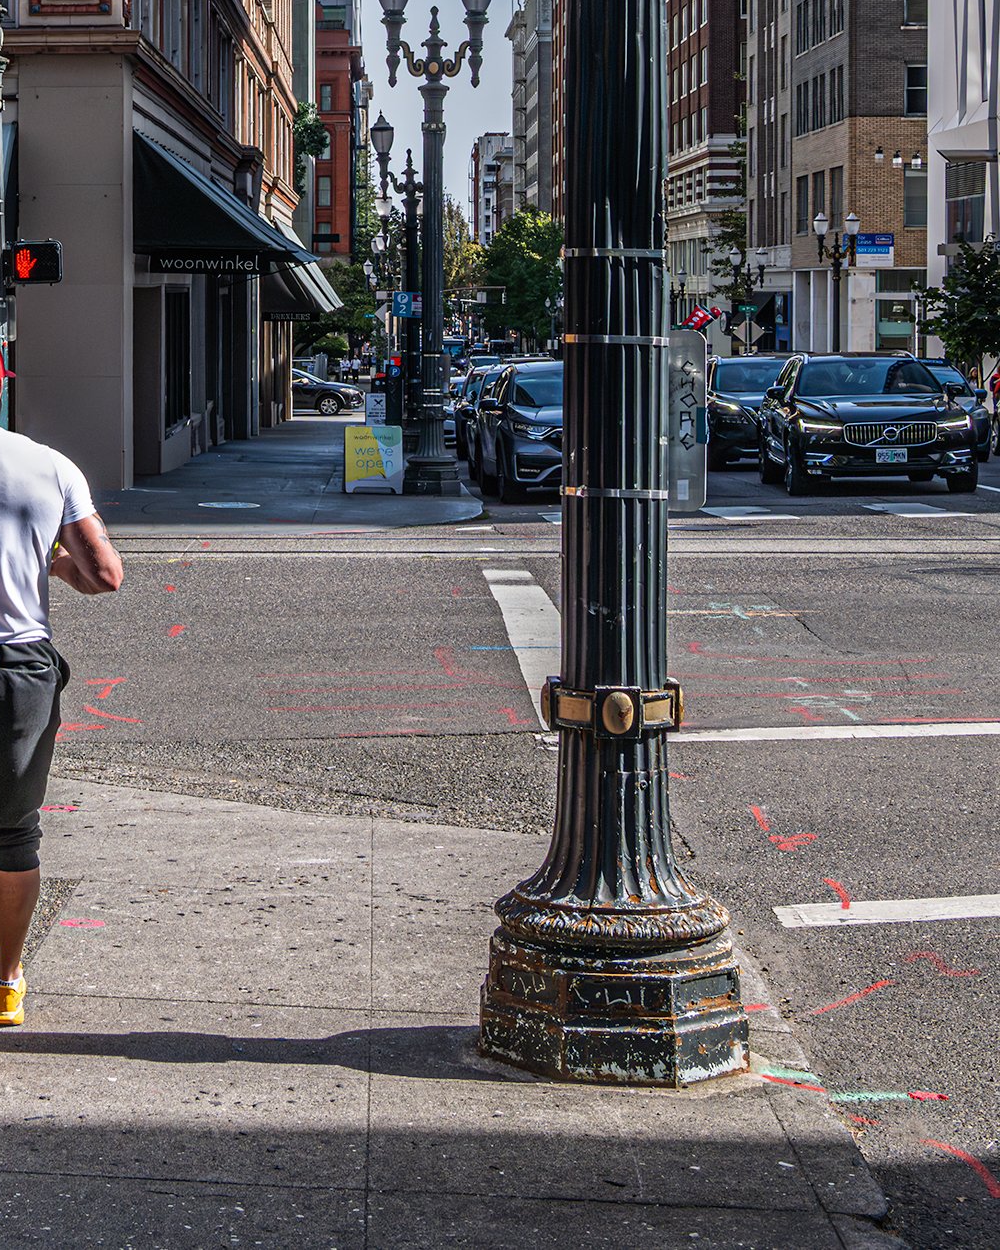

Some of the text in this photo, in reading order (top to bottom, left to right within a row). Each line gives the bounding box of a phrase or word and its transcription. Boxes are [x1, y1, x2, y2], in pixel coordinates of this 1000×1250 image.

[159, 254, 260, 271] woonwinkel
[398, 304, 407, 314] 2
[355, 457, 394, 473] open
